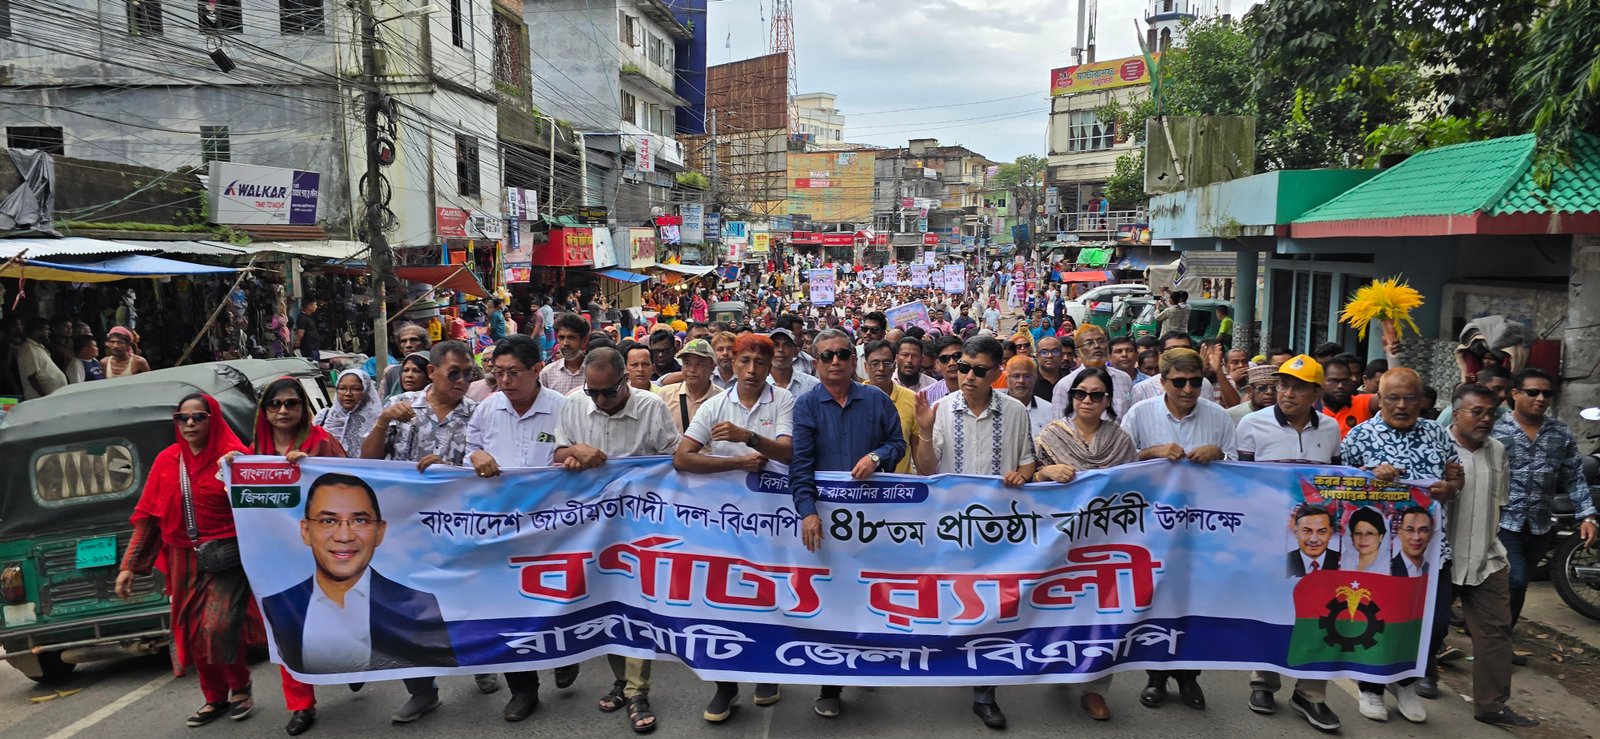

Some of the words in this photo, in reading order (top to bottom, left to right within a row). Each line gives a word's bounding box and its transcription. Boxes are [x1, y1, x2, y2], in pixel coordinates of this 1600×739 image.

[238, 183, 287, 199] WALKAR
[240, 468, 294, 480] বাংলাদেশ
[240, 489, 291, 504] জিন্দাবাদ
[828, 484, 879, 500] রাহমানির
[883, 484, 915, 500] রাহিম
[420, 509, 520, 536] বাংলাদেশ
[531, 492, 667, 532] জাতীয়তাবাদী
[829, 508, 926, 546] ৪৮তম
[937, 508, 1044, 551] প্রতিষ্ঠা
[1056, 493, 1150, 541] বার্ষিকী
[1153, 503, 1245, 534] উপলক্ষে
[508, 536, 830, 618] বর্ণাঢ্য
[500, 612, 754, 661] রাঙ্গামাটি
[775, 640, 943, 672] জেলা
[964, 624, 1185, 668] বিএনপি
